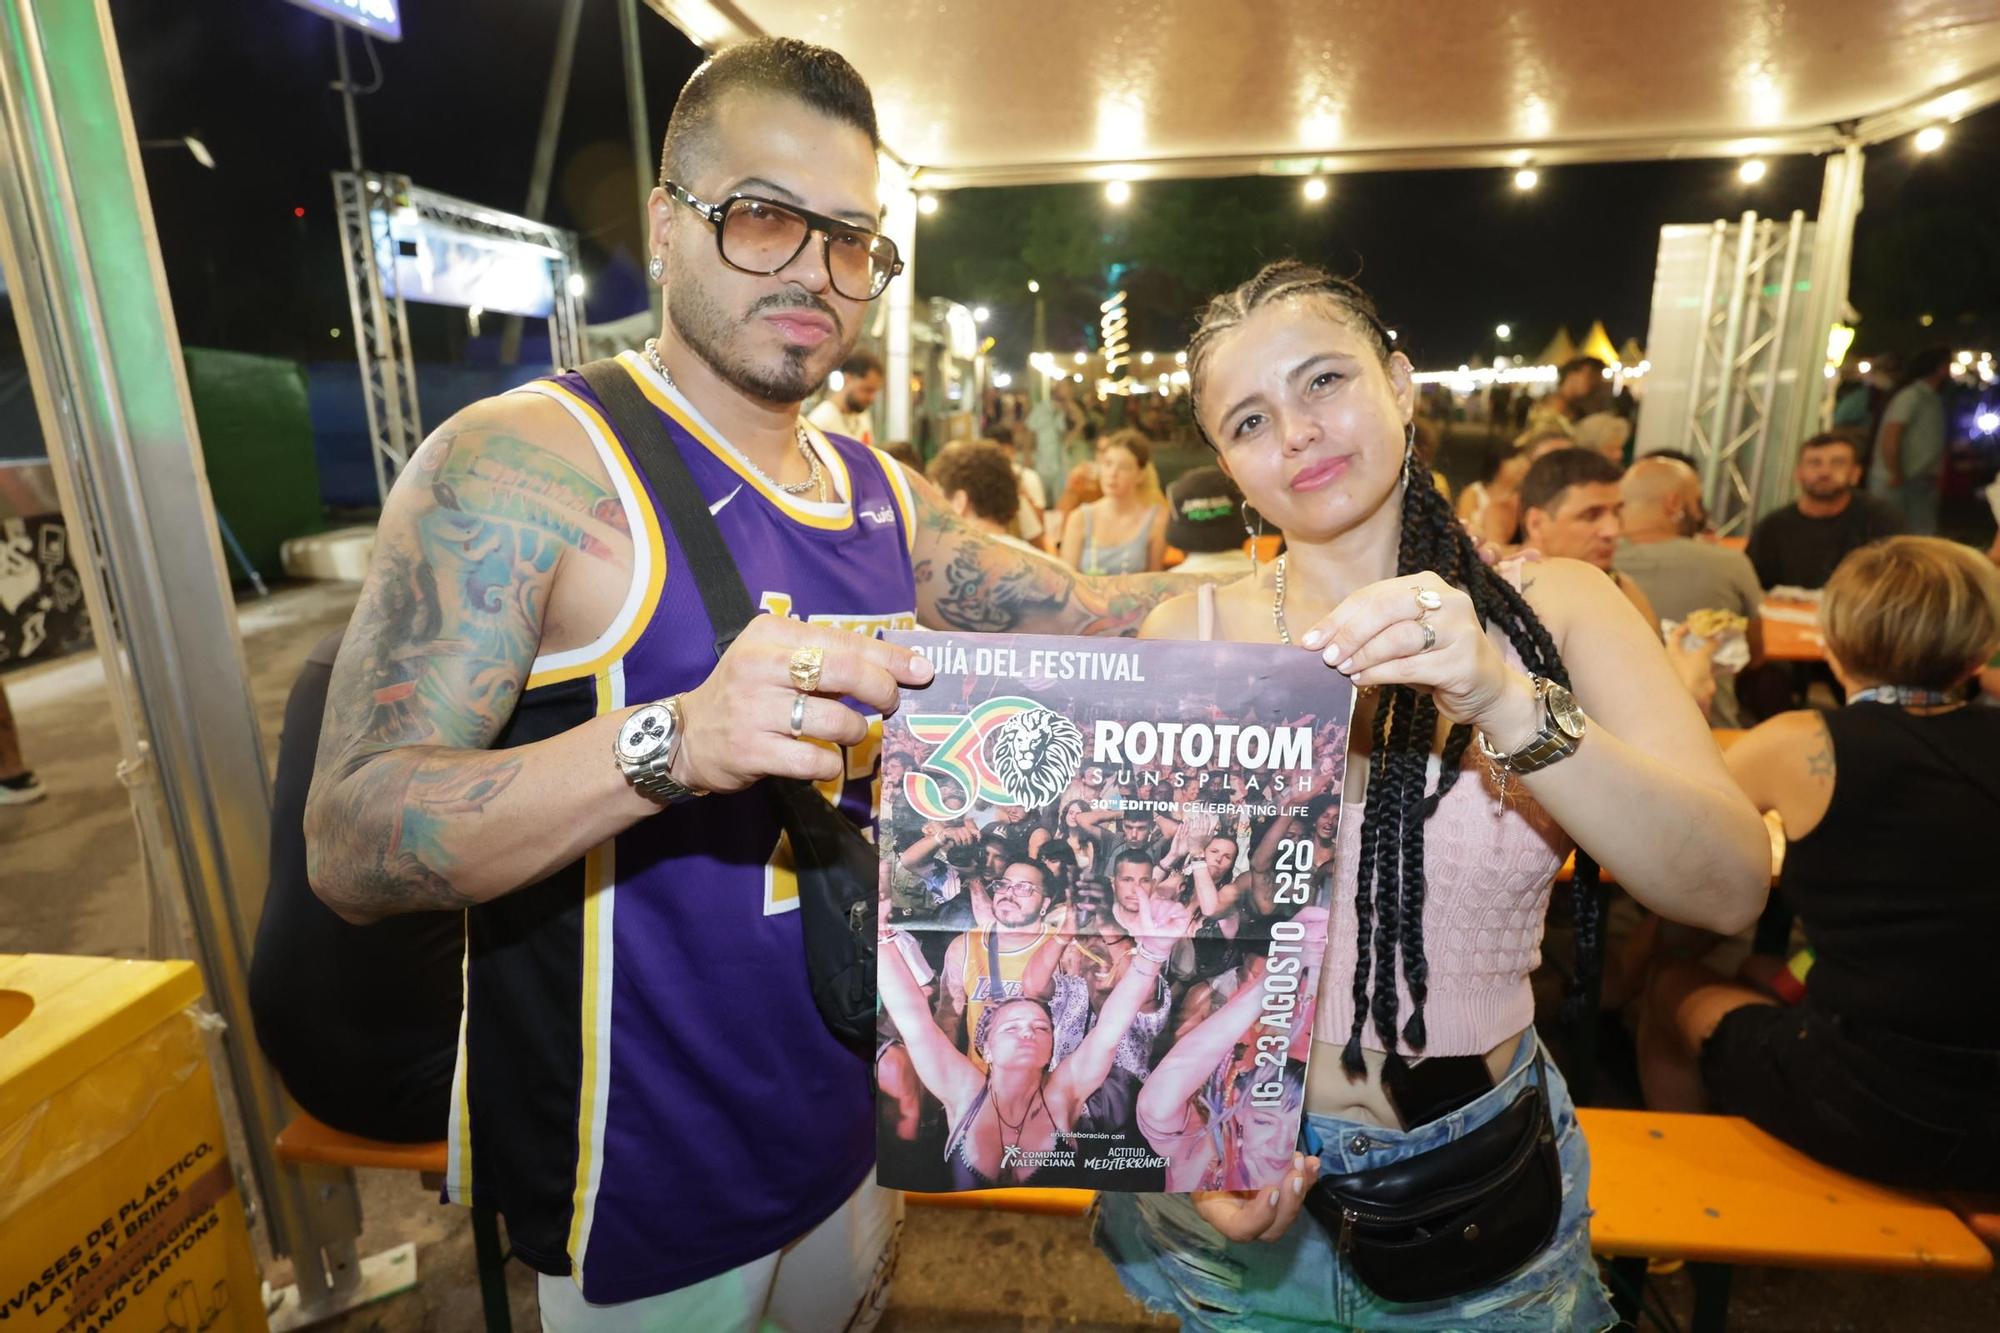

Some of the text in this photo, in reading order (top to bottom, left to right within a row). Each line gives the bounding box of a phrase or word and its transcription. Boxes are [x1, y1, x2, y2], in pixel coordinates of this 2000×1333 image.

[910, 640, 1145, 682] UÍA DEL FESTIVAL
[1093, 720, 1313, 770] ROTOTOM
[1092, 769, 1312, 792] SUNSPLASH
[1120, 799, 1178, 812] EDITION
[1182, 802, 1276, 816] CELEBRATING
[1281, 806, 1309, 817] LIFE
[1275, 839, 1314, 872] 20
[1273, 873, 1311, 905] 25
[1260, 921, 1306, 1029] AGOSTO
[1062, 1131, 1109, 1140] colaboración
[1010, 1158, 1075, 1168] VALENCIANA
[1022, 1151, 1075, 1159] COMUNITAT
[1084, 1155, 1170, 1171] MEDITERRÁNEA
[1108, 1147, 1145, 1157] ACTITUD
[86, 1217, 115, 1248] DE
[33, 1185, 179, 1317] LATAS Y BRIKS
[133, 1213, 219, 1296] CARTONS
